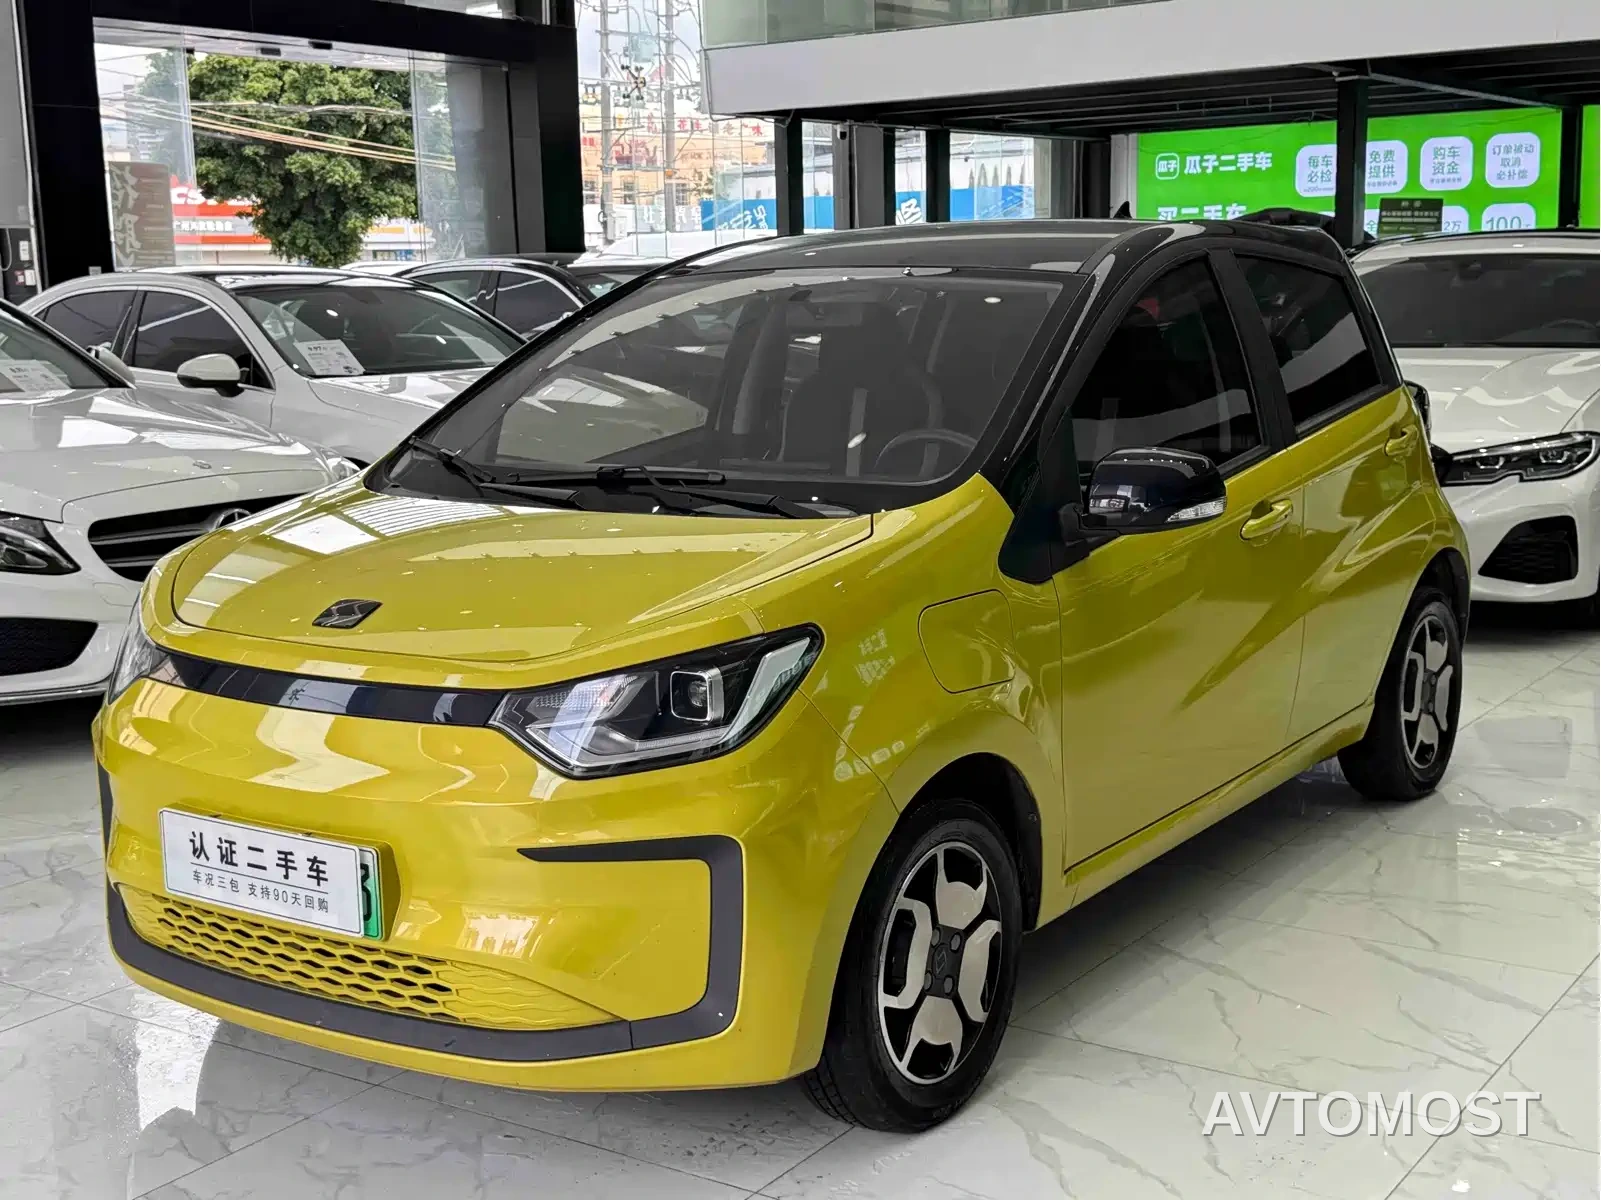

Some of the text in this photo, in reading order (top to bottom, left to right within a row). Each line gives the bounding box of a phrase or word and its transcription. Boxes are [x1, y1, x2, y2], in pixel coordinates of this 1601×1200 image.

[1369, 149, 1395, 163] 免费
[1433, 146, 1461, 160] 购车
[1157, 160, 1178, 173] 瓜子
[1184, 151, 1273, 174] 瓜子二手车
[1307, 155, 1333, 168] 每车
[1432, 161, 1459, 175] 资金
[1307, 170, 1332, 183] 必检
[1368, 164, 1395, 178] 提供
[189, 831, 329, 886] 认证二手车
[192, 870, 240, 893] 车况三包
[248, 882, 329, 913] 支持90天回购
